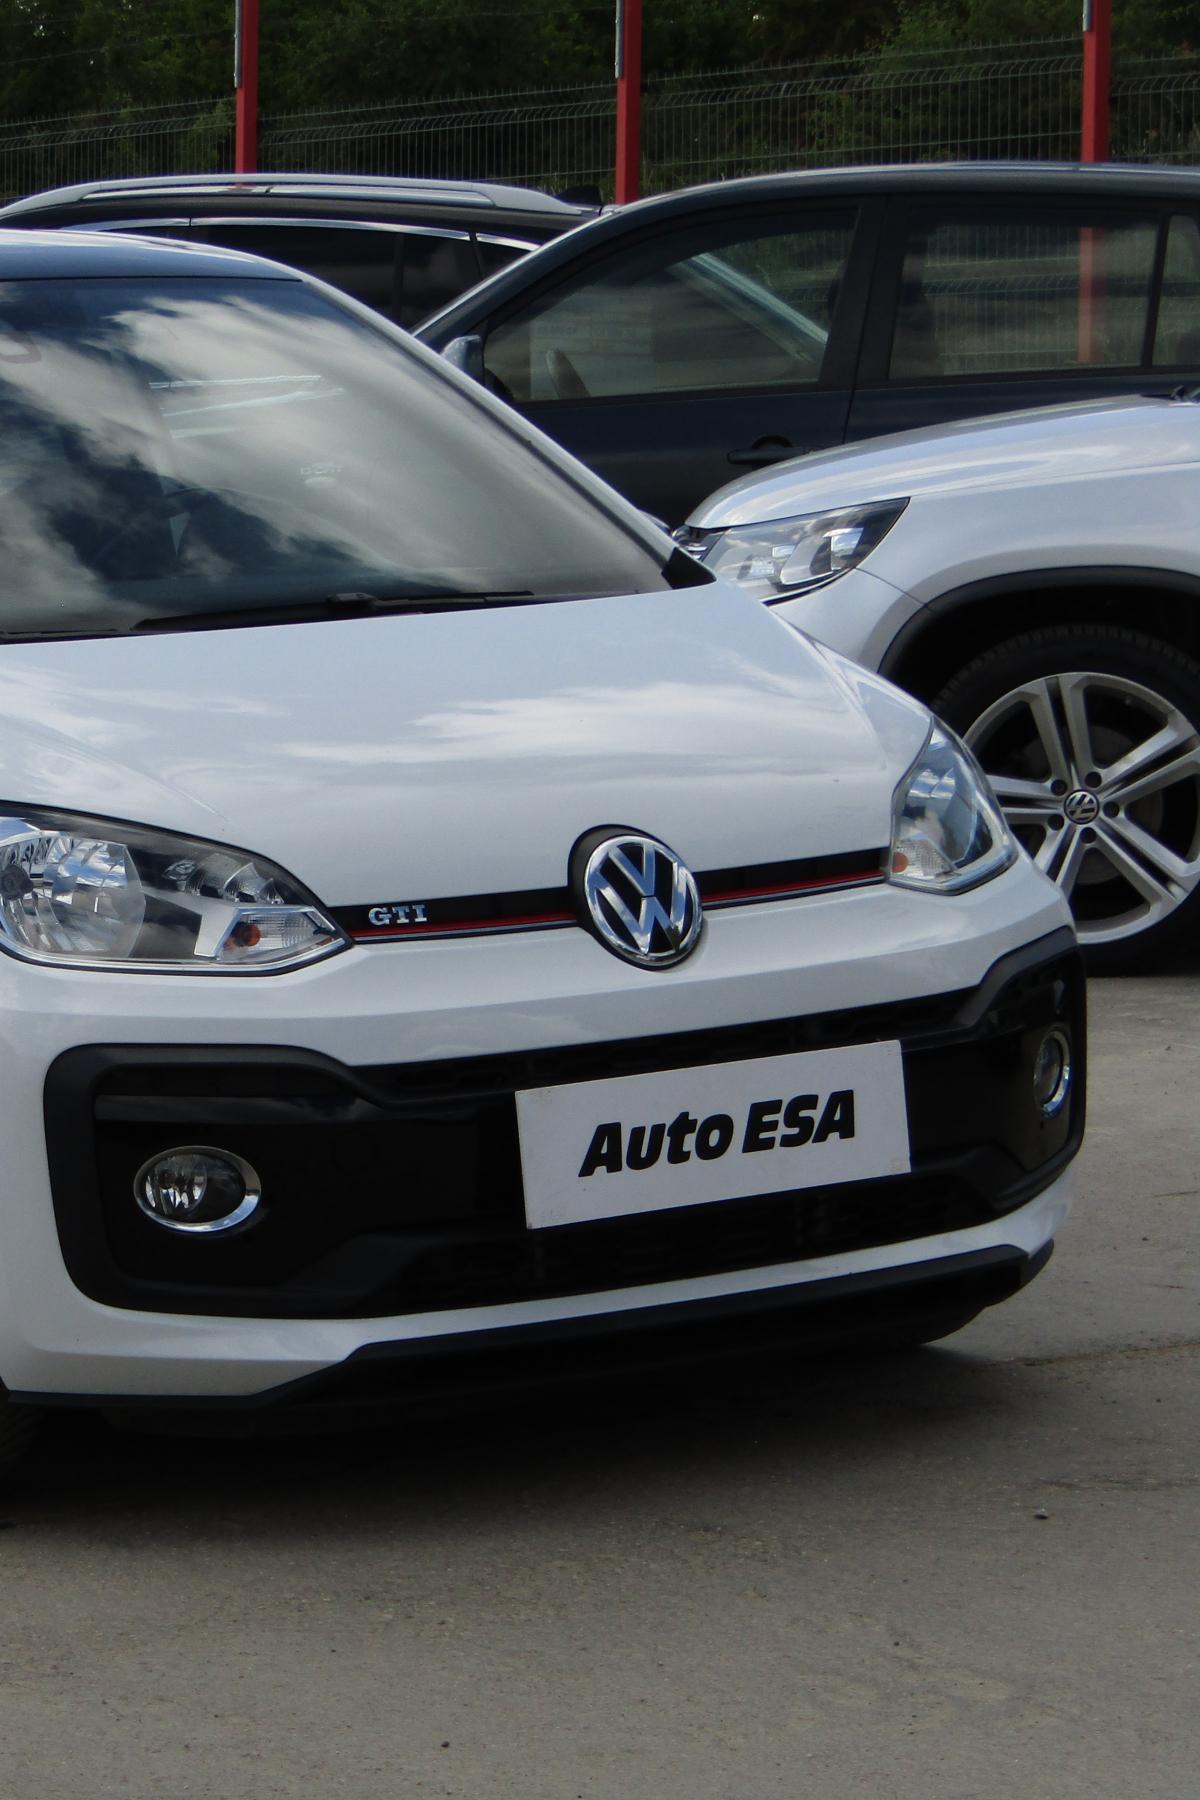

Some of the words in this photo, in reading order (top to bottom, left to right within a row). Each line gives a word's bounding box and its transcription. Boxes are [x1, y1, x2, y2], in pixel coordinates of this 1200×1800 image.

[368, 904, 428, 926] GTI
[577, 1110, 735, 1178] Auto
[741, 1089, 856, 1154] ESA
